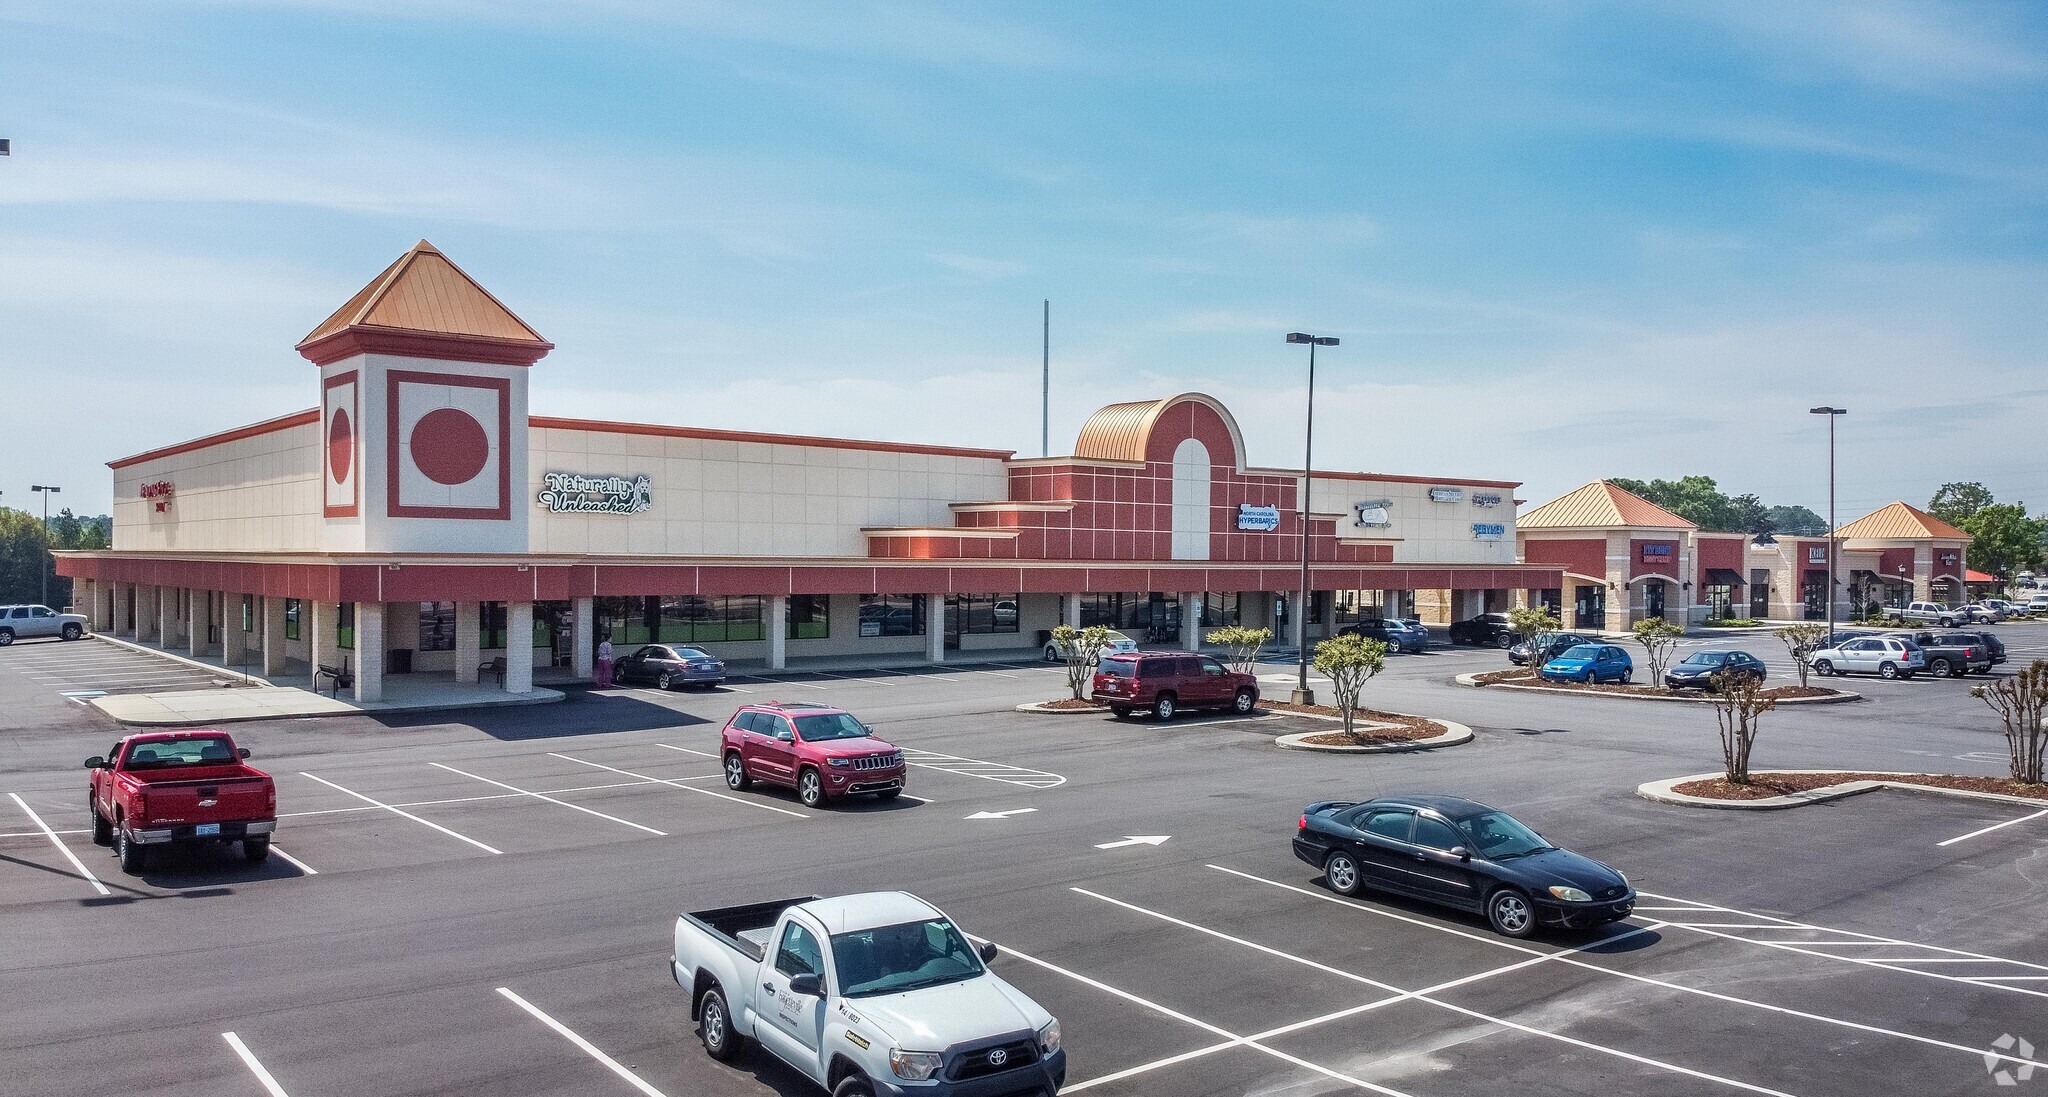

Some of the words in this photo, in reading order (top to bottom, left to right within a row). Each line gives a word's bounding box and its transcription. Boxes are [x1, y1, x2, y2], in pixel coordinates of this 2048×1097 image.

[545, 473, 633, 499] Naturally
[539, 493, 640, 514] Unleashed
[1239, 517, 1278, 525] HYPERBARICS
